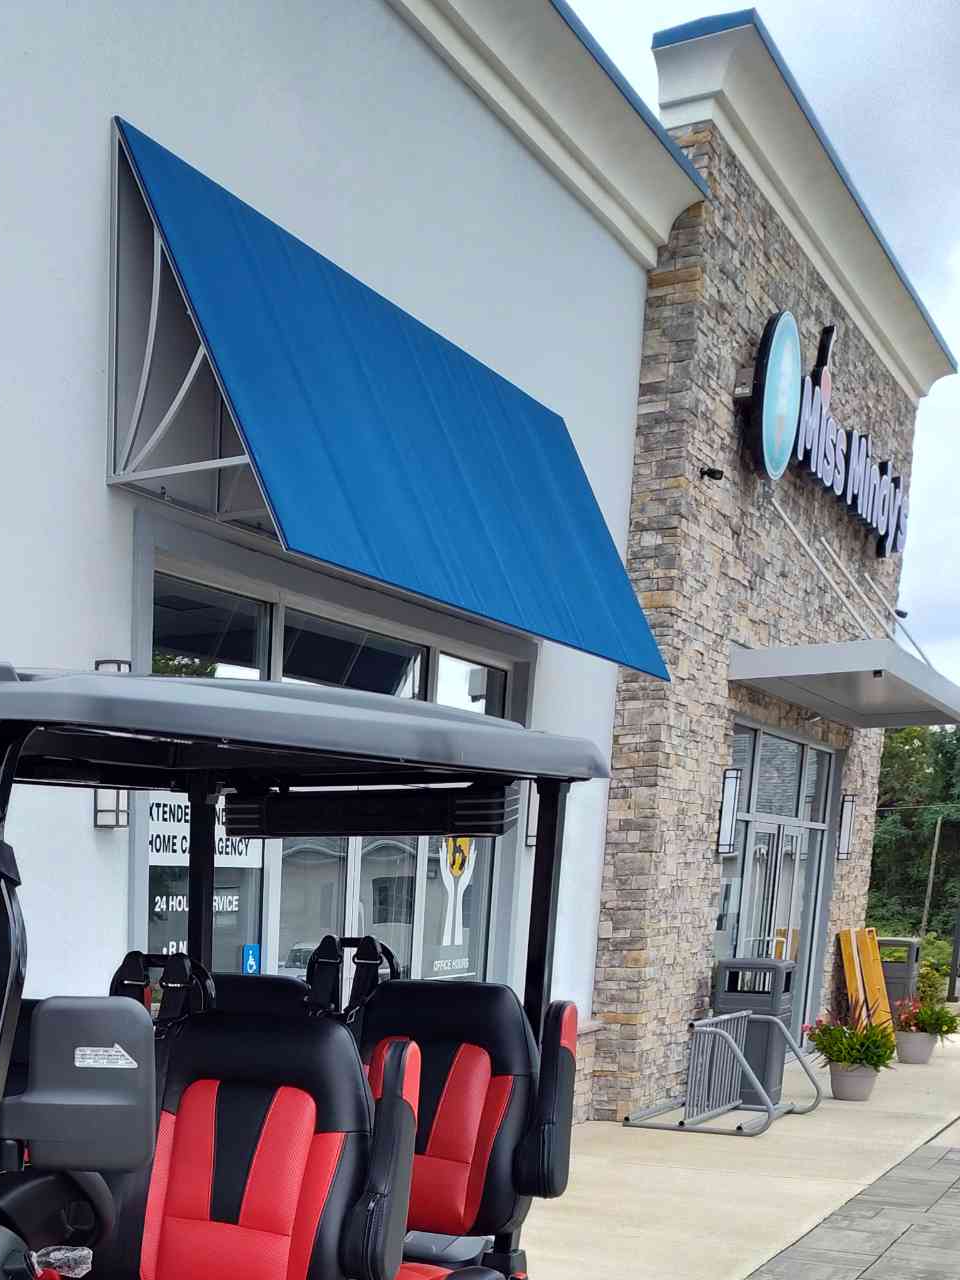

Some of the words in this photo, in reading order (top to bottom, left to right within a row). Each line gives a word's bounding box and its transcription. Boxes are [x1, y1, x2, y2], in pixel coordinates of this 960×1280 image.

[214, 838, 250, 857] GENCY
[154, 895, 167, 912] 24
[212, 895, 240, 912] RVICE
